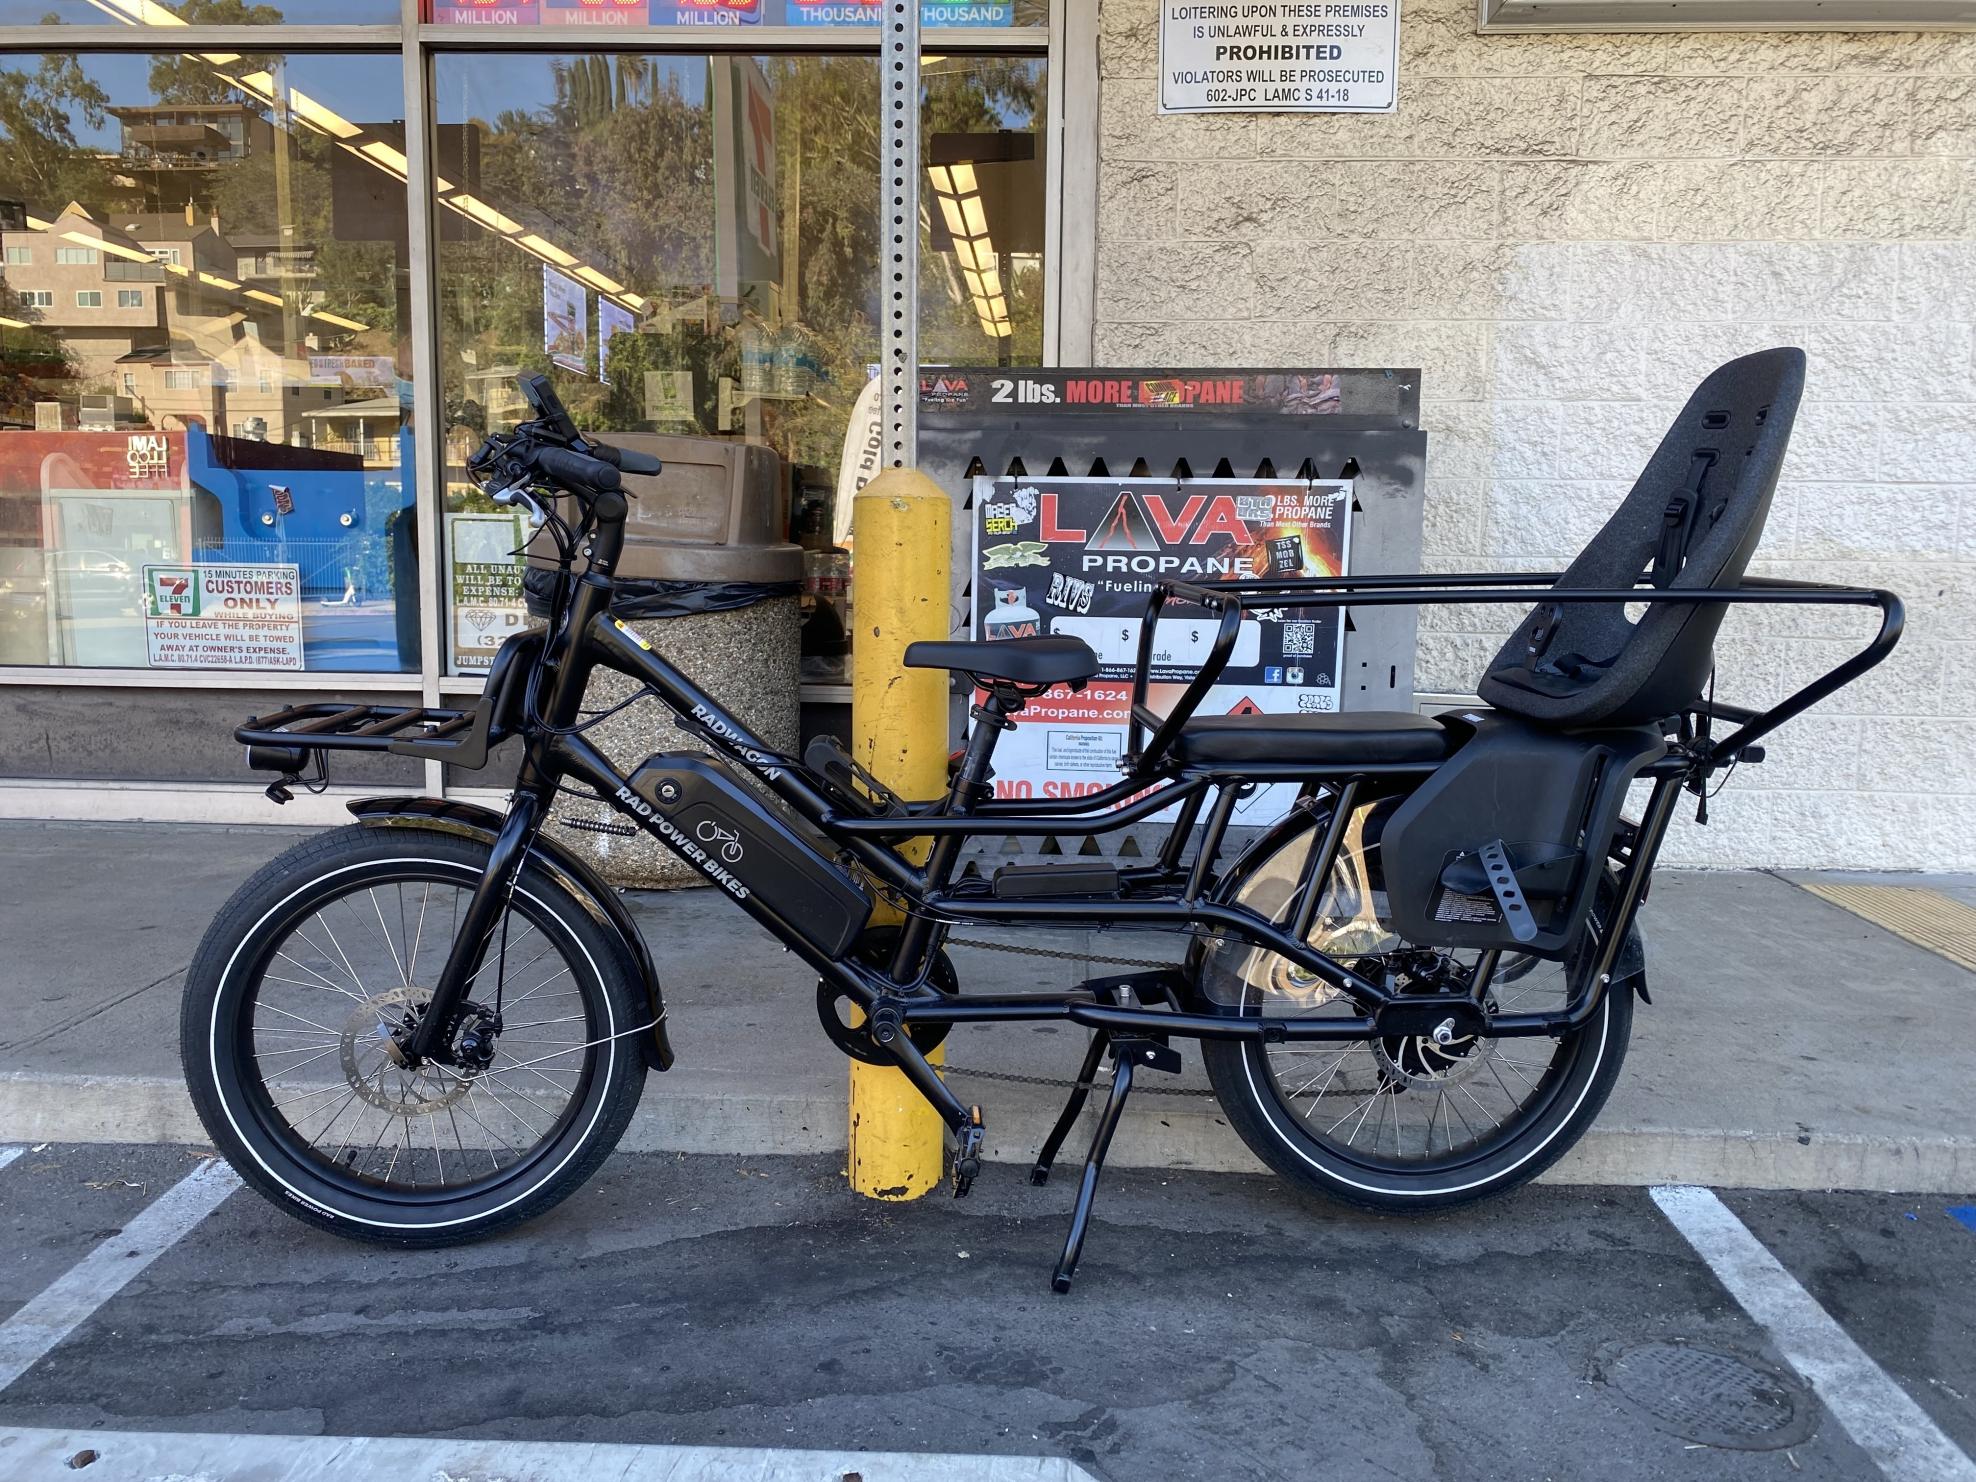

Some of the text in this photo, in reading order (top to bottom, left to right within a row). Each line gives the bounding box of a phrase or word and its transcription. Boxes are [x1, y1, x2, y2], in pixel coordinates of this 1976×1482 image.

[455, 11, 518, 25] MILLION
[565, 11, 628, 25] MILLION
[676, 11, 740, 25] MILLION
[801, 8, 881, 22] THOUSAN
[921, 7, 1003, 21] HOUSAND
[1172, 4, 1388, 20] LOITERING UPON THESE PREMISES
[1193, 25, 1365, 38] IS UNLAWFUL & EXPRESSLY
[1215, 45, 1342, 60] PROHIBITED
[1173, 70, 1384, 84] VIOLATORS WILL BE PROSECUTED
[1206, 88, 1349, 102] 602-JPC LAMC S 41-18
[991, 379, 1014, 403] 2
[1018, 380, 1060, 403] lbs.
[1066, 380, 1132, 404] MORE
[1139, 380, 1243, 404] PANE
[1277, 495, 1335, 507] LBS. MORE
[1040, 490, 1255, 551] LAVA
[1275, 507, 1334, 520] PROPANE
[466, 564, 527, 575] ALL UNAUT
[1082, 555, 1254, 576] PROPANE
[204, 570, 295, 580] 15 MINUTES PARKING
[456, 575, 522, 585] WILL BE TO
[205, 580, 293, 596] CUSTOMERS
[463, 586, 519, 596] EXPENSE:
[1098, 580, 1152, 593] “Fuelin
[223, 597, 279, 611] ONLY
[214, 611, 247, 620] WHILE
[156, 620, 290, 631] IF YOU LEAVE THE PROPERTY
[153, 632, 294, 643] YOUR VEHICLE WILL BE TOWED
[1121, 629, 1129, 641] $
[1191, 630, 1199, 643] $
[160, 644, 186, 652] AWAY
[202, 645, 243, 653] OWNER'S
[246, 646, 290, 655] EXPENSE.
[1153, 650, 1172, 661] rade
[456, 656, 496, 665] JUMPST
[691, 703, 782, 781] RADWAGON
[996, 779, 1033, 800] NO
[615, 785, 751, 899] RAD POWER BIKES
